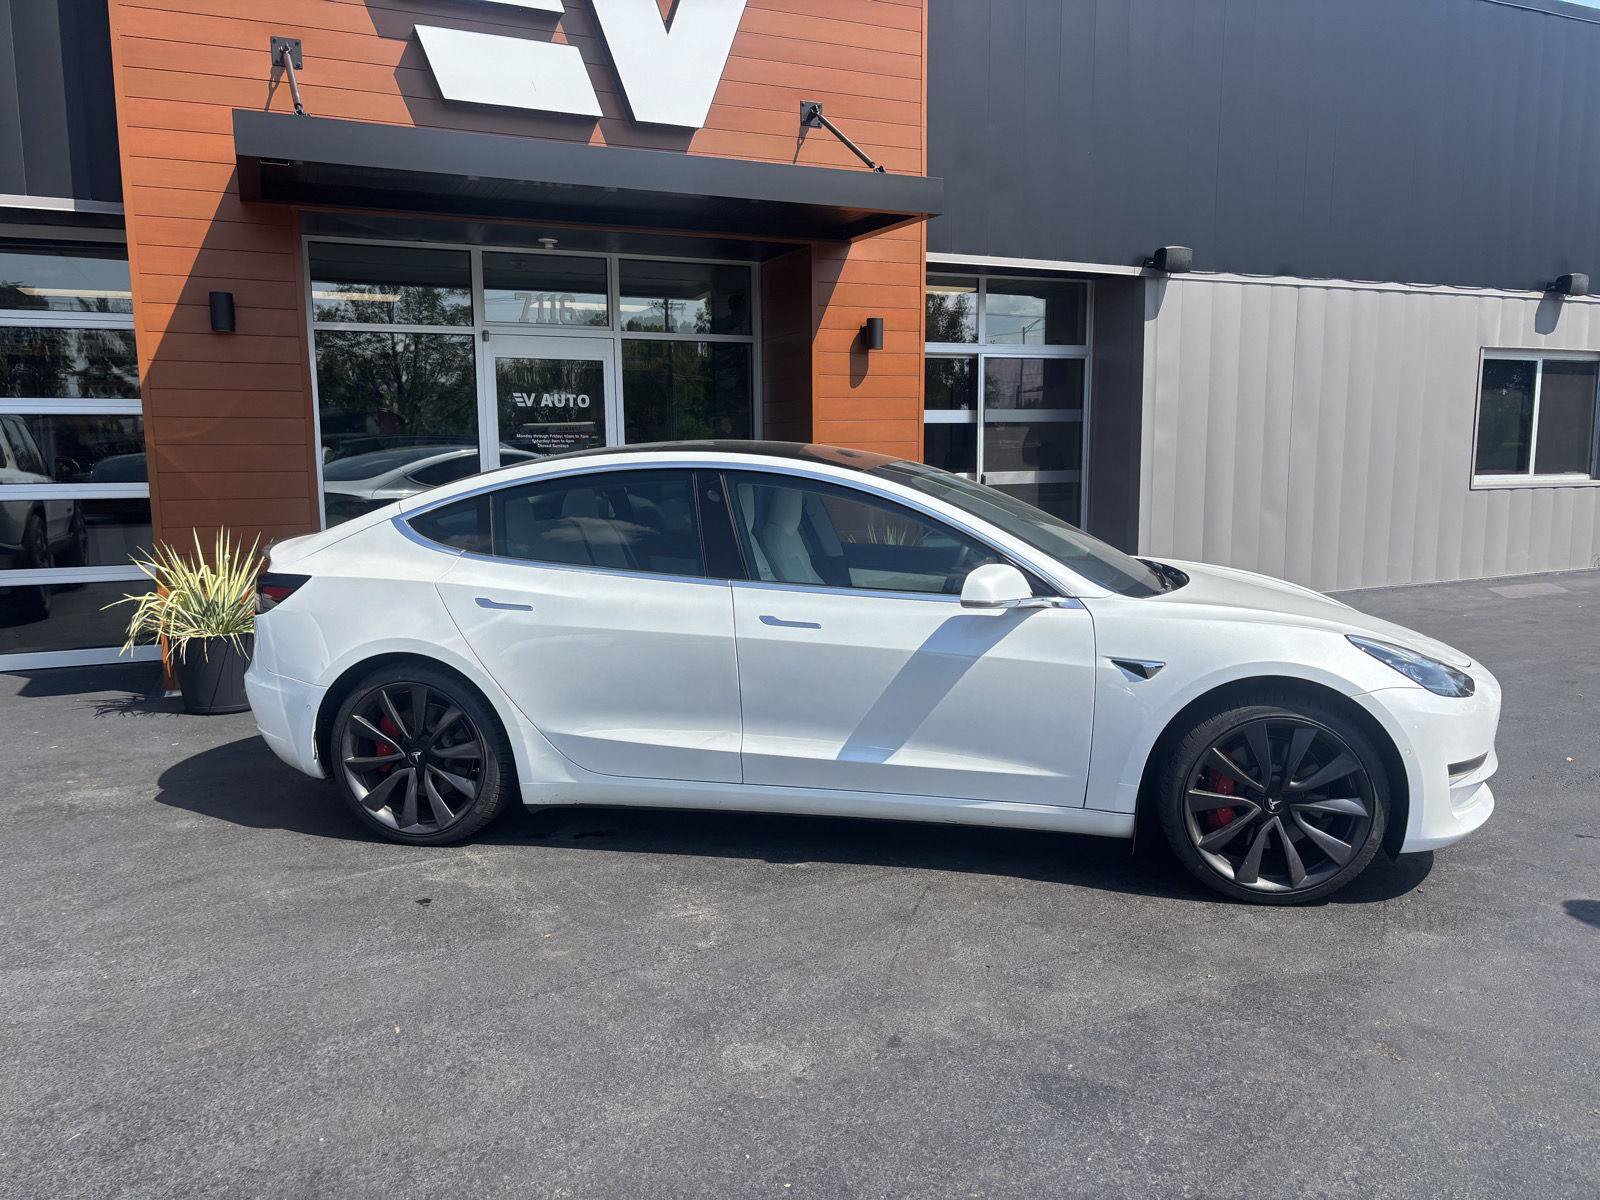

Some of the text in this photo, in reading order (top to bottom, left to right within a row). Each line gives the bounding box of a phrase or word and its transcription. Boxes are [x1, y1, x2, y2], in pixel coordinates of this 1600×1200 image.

[514, 293, 576, 325] 7116
[513, 393, 590, 408] EV AUTO
